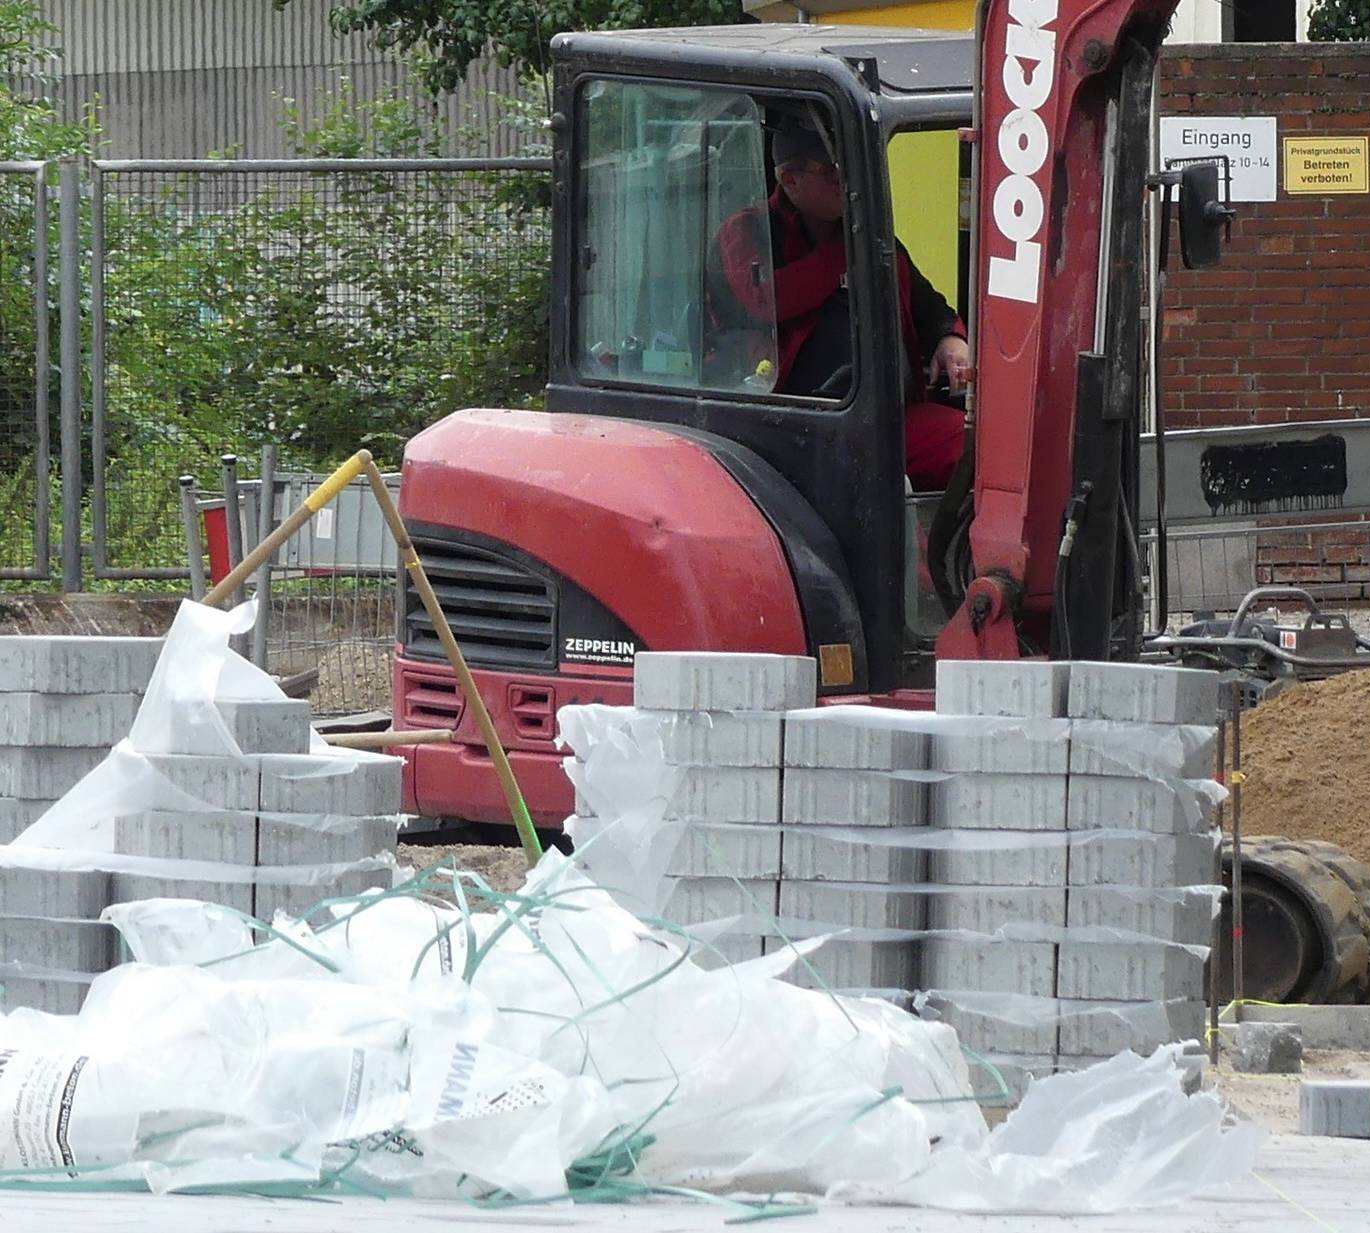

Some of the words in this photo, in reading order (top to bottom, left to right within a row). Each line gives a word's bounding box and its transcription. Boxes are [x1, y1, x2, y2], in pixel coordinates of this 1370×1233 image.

[1182, 128, 1251, 148] Eingang
[988, 0, 1059, 304] LOOCK
[1291, 147, 1361, 156] Privatgrundstück
[1304, 160, 1350, 170] Betreten
[1301, 174, 1352, 184] verboten!
[565, 638, 634, 654] ZEPPELIN
[565, 653, 633, 663] www.zeppelin.de
